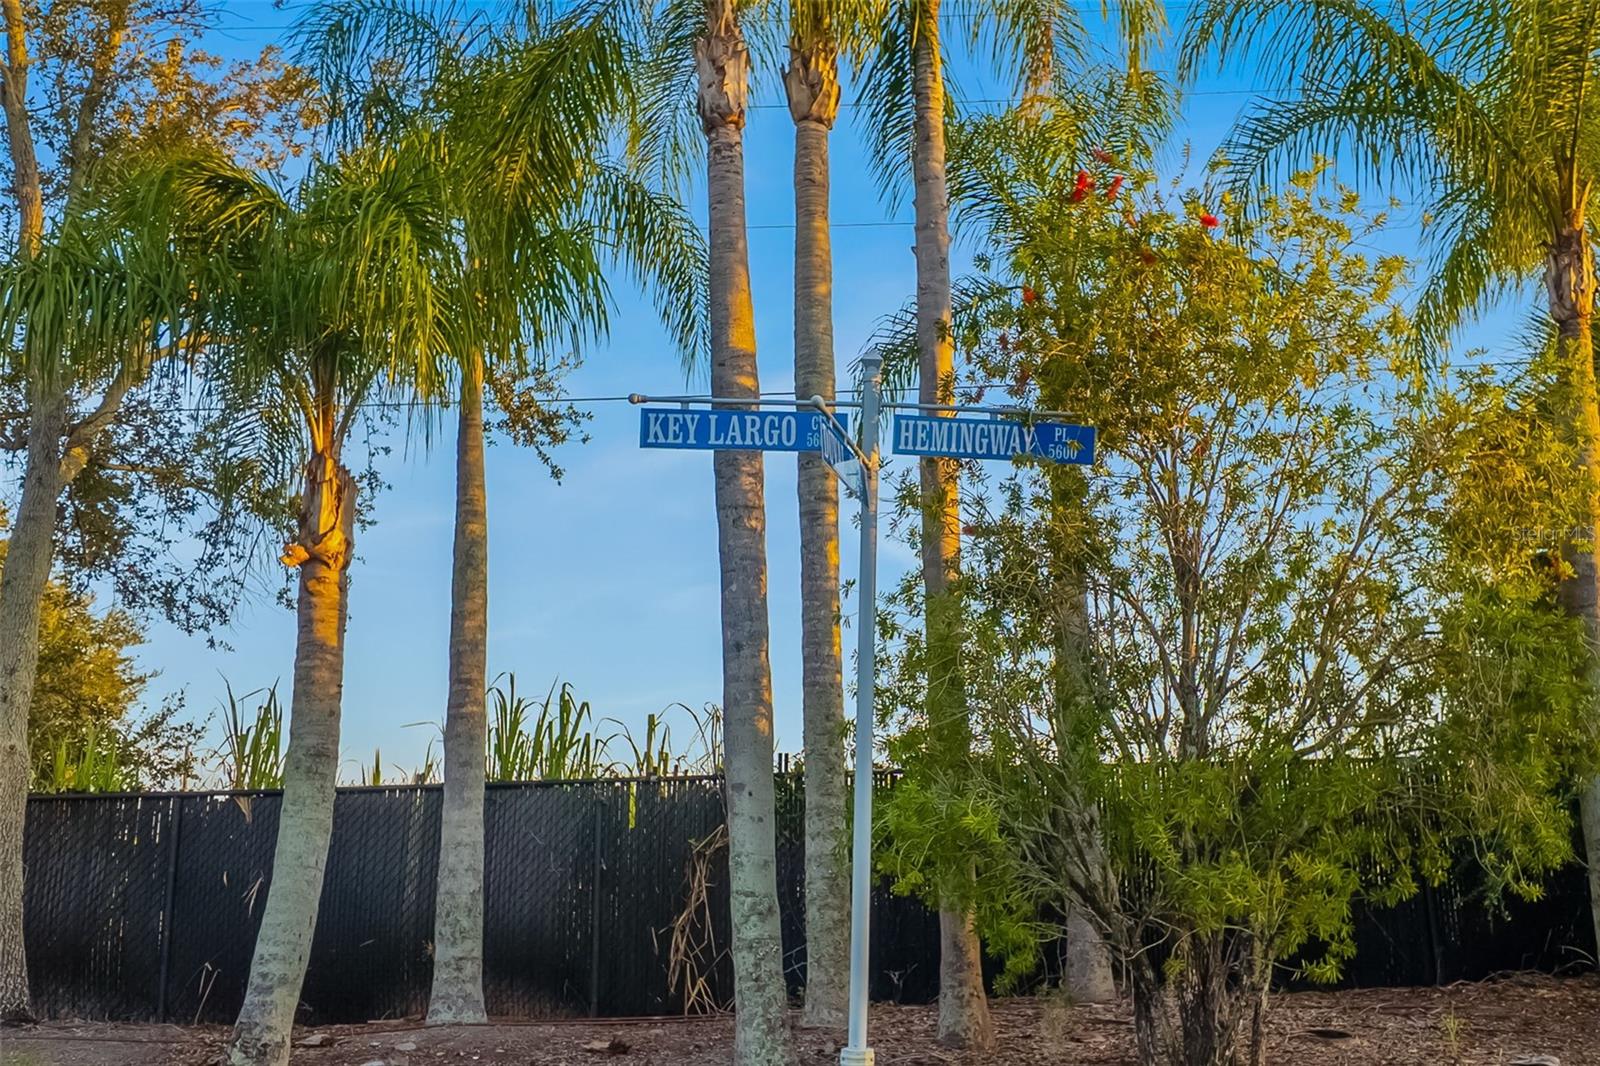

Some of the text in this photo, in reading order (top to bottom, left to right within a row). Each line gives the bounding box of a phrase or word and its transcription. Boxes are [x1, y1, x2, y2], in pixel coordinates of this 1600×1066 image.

[647, 412, 700, 444] KEY
[708, 414, 797, 447] LARGO
[898, 419, 1035, 456] HEMINGWAY
[1055, 427, 1070, 442] PL
[1048, 443, 1078, 460] 5600
